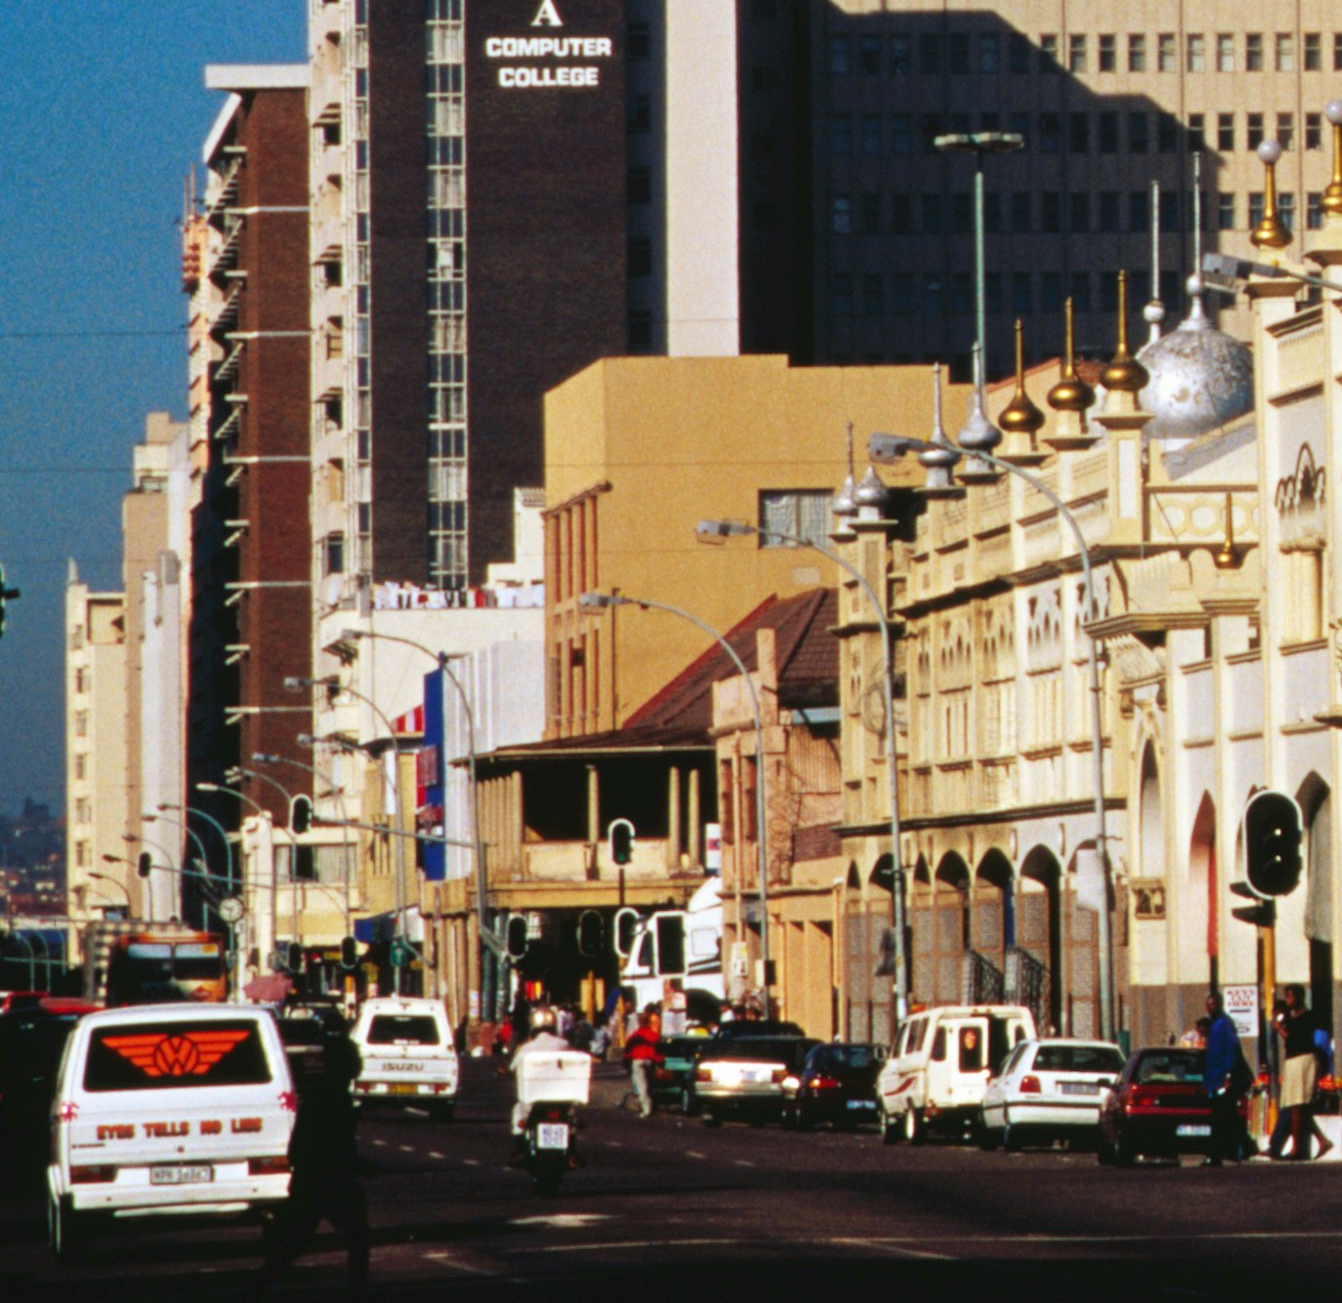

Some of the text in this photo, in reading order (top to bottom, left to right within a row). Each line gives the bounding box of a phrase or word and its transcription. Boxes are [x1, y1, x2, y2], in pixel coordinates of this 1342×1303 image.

[485, 37, 612, 57] COMPUTER
[498, 67, 599, 87] COLLEGE
[382, 1063, 424, 1072] ISUZU
[97, 1124, 136, 1140] EYES
[201, 1120, 223, 1135] NO
